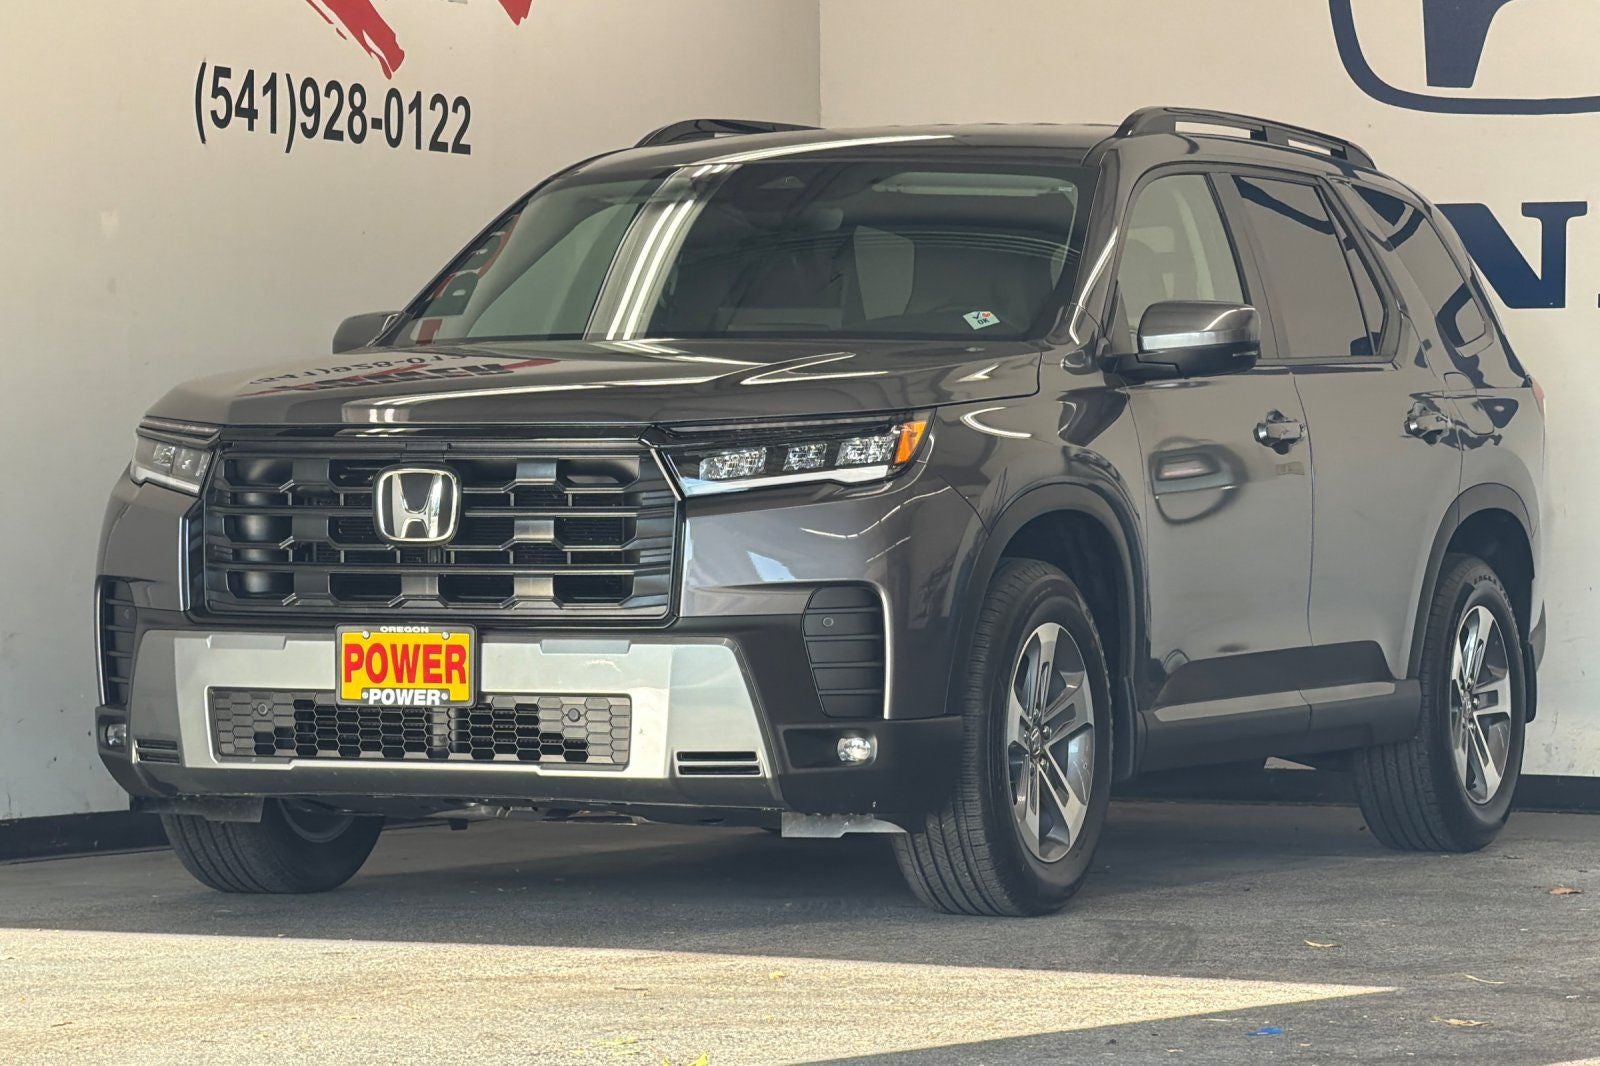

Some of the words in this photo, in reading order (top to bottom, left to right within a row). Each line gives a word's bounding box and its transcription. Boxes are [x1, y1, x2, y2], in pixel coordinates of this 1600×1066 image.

[195, 61, 471, 155] (541)928-0122
[344, 643, 467, 684] POWER
[368, 688, 440, 705] POWER
